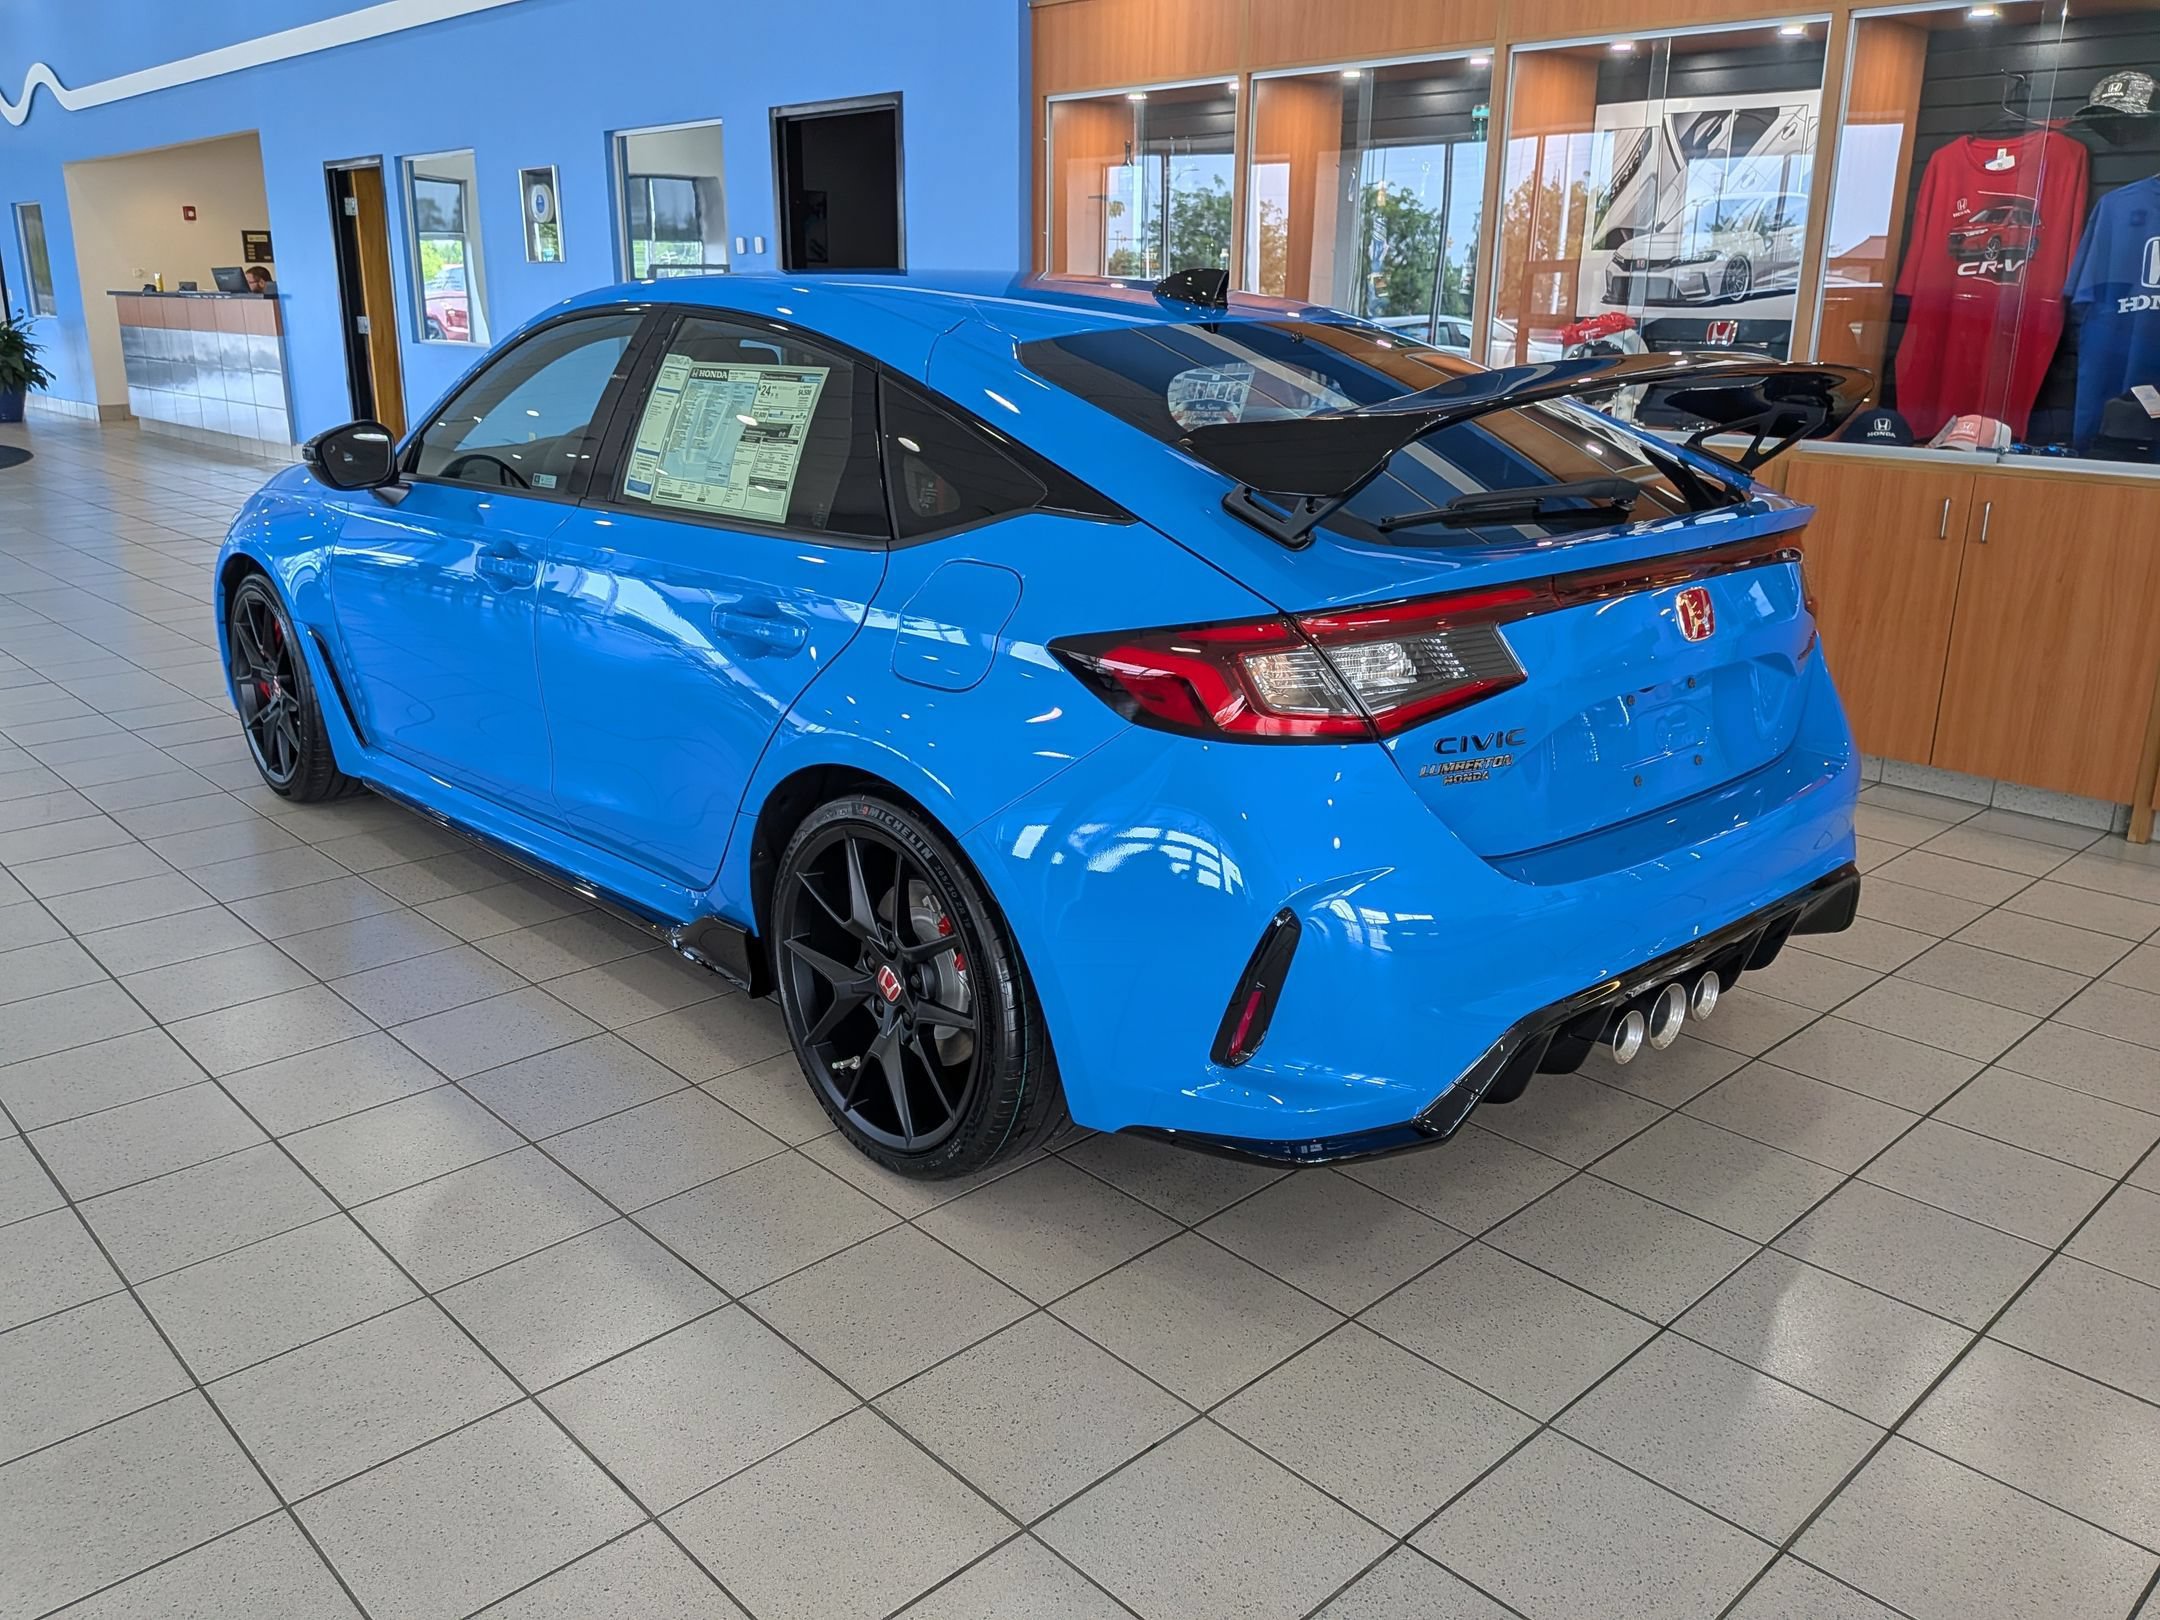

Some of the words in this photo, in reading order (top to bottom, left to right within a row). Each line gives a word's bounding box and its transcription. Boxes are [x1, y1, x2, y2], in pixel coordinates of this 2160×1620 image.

[1957, 259, 2025, 275] CR-V
[699, 369, 728, 379] HONDA
[760, 385, 771, 396] 24
[1434, 728, 1527, 755] CIVIC
[1419, 754, 1513, 778] LUMBERTON
[1443, 770, 1489, 785] HONDA
[869, 805, 933, 860] MICHELIN
